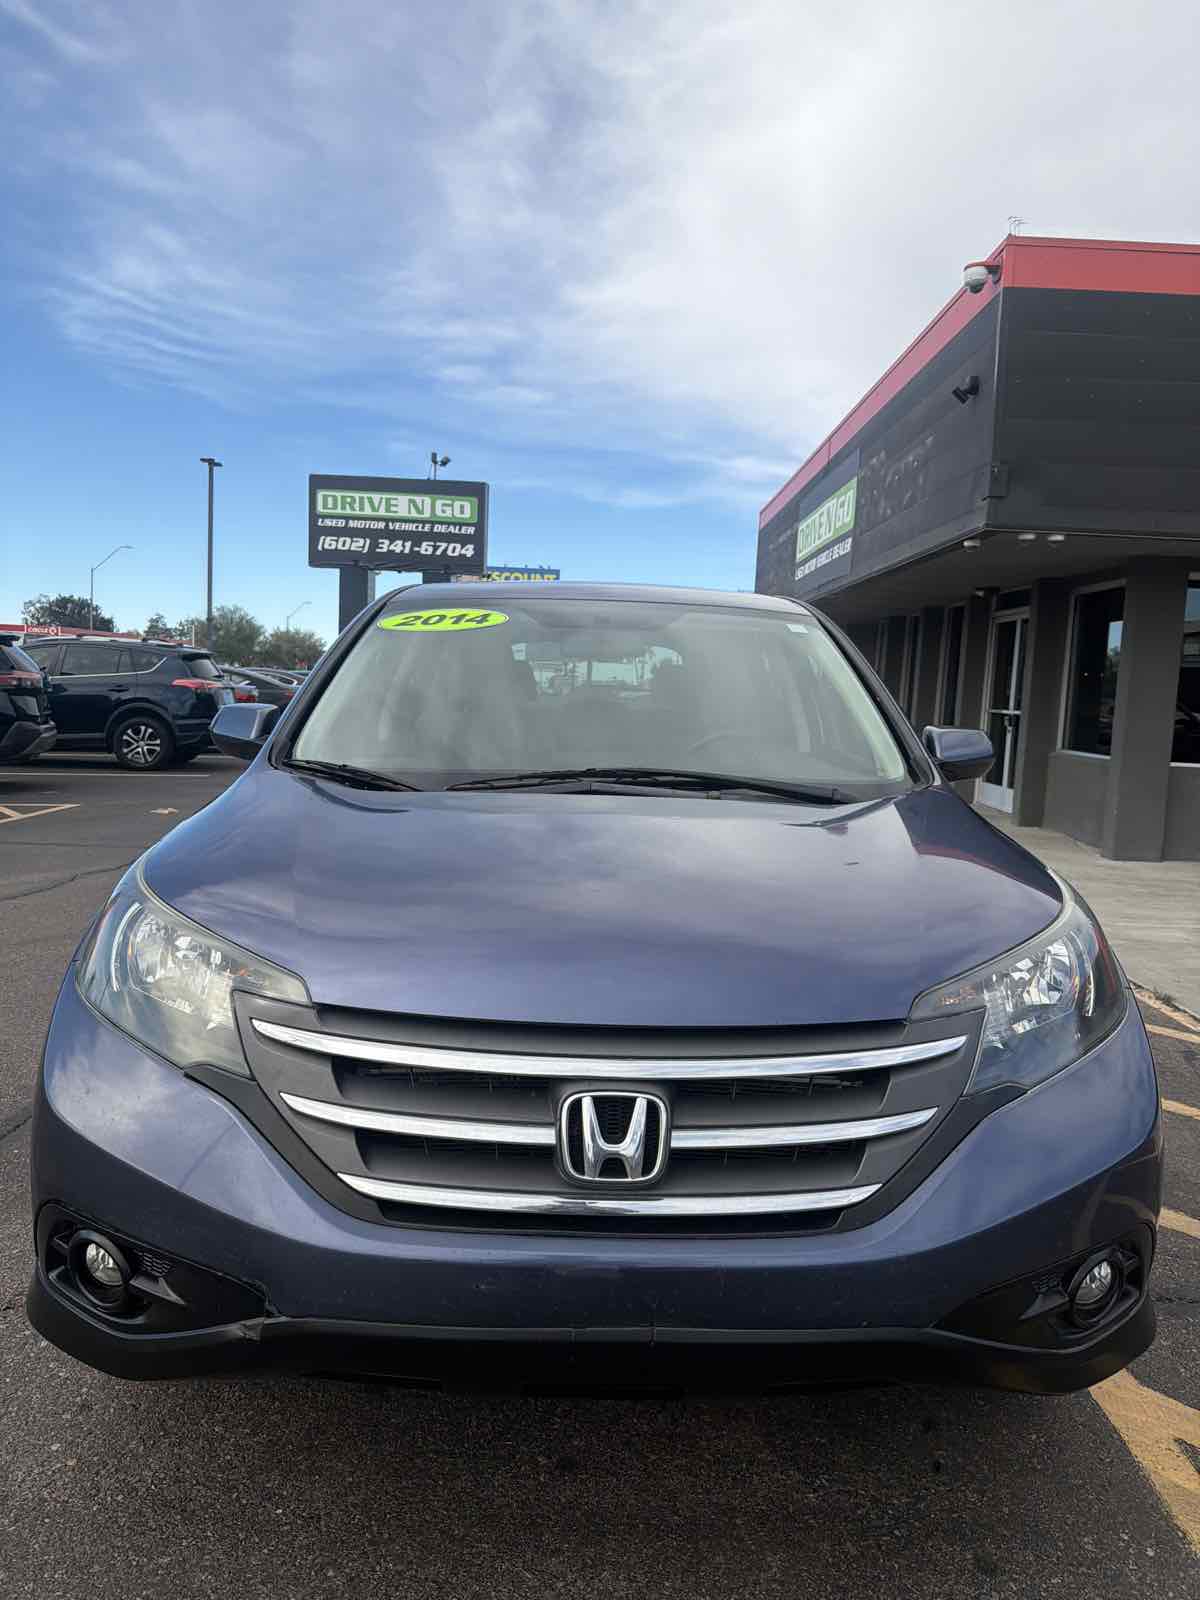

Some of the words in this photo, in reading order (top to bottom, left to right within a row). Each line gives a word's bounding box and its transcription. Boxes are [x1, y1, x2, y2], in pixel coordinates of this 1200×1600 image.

[322, 494, 399, 513] DRIVE
[407, 498, 425, 515] N
[435, 499, 471, 518] GO
[318, 518, 346, 528] USED
[347, 519, 386, 529] MOTOR
[388, 522, 431, 532] VEHICLE
[433, 524, 476, 535] DEALER
[318, 535, 370, 553] (602)
[375, 538, 475, 557] 341-6704
[392, 613, 490, 626] 2014
